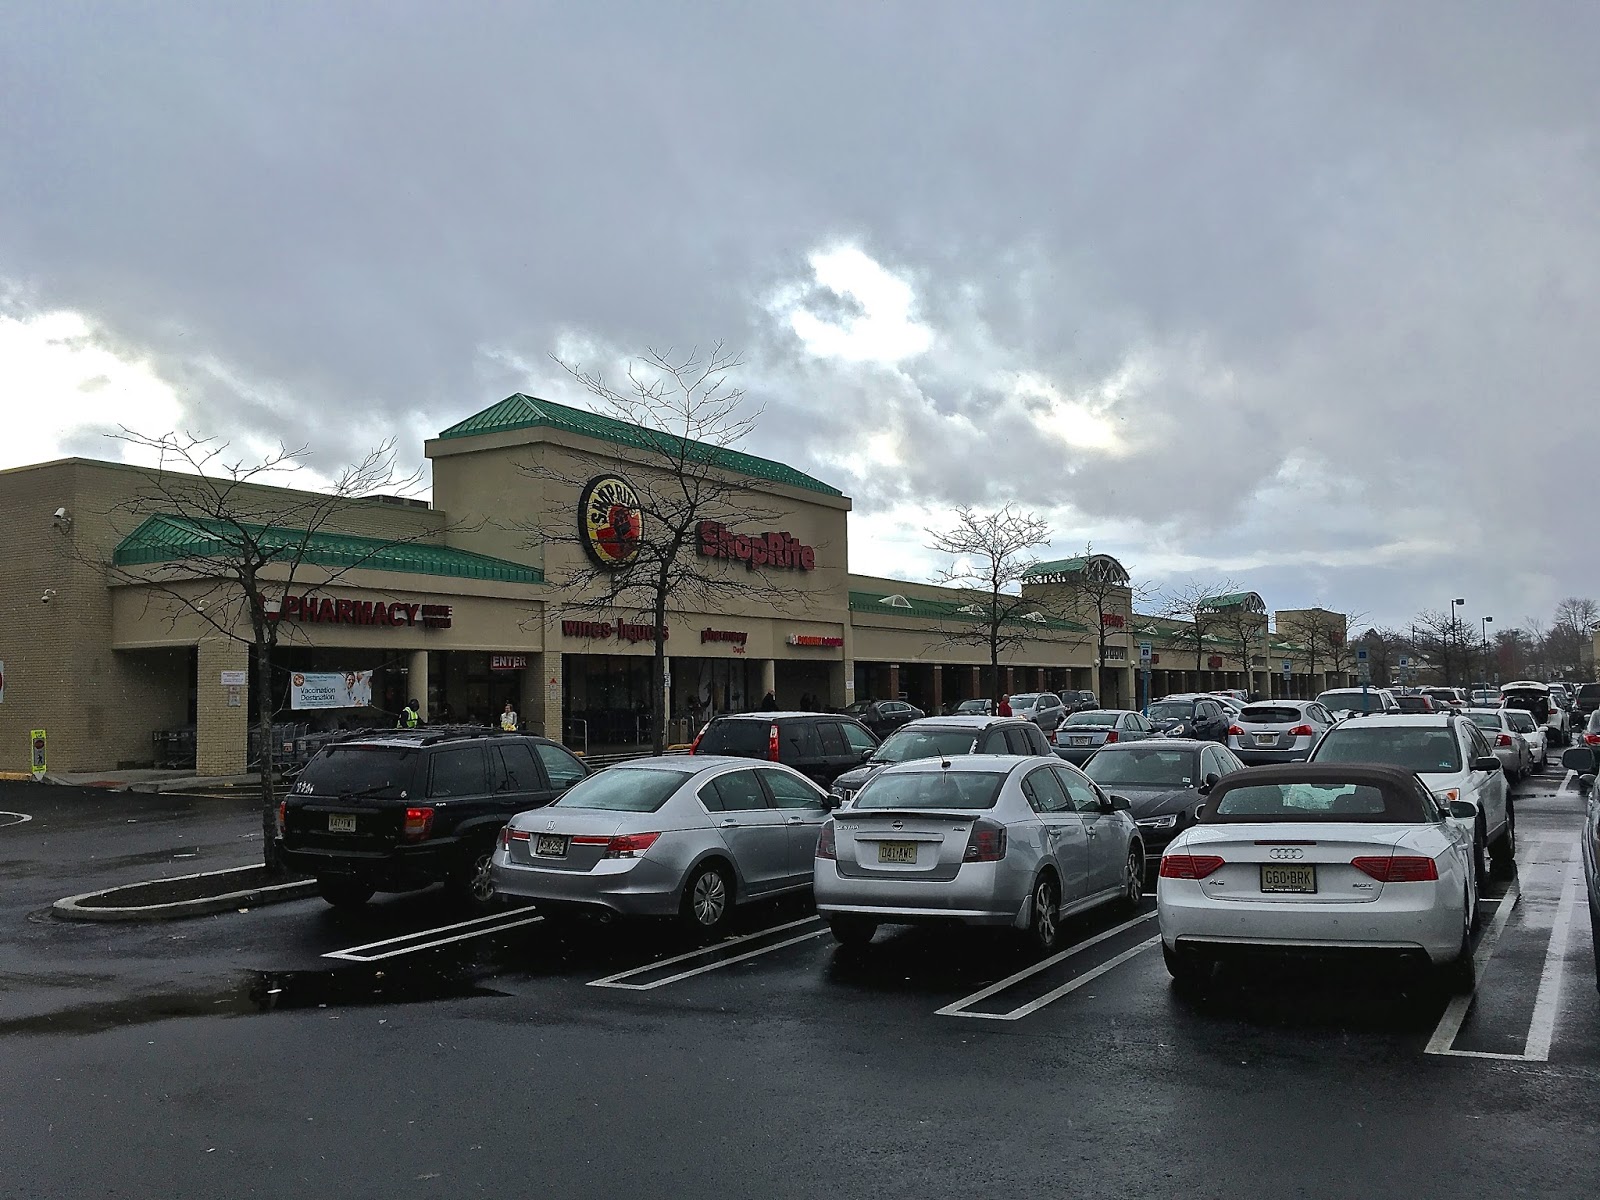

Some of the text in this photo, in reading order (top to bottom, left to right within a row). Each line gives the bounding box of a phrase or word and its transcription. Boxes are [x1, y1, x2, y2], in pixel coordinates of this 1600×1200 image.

[590, 484, 640, 526] SHOPRIT
[697, 520, 815, 572] ShopRite
[280, 595, 420, 627] PHARMACY
[492, 655, 527, 667] ENTER
[300, 686, 336, 694] Vaccination
